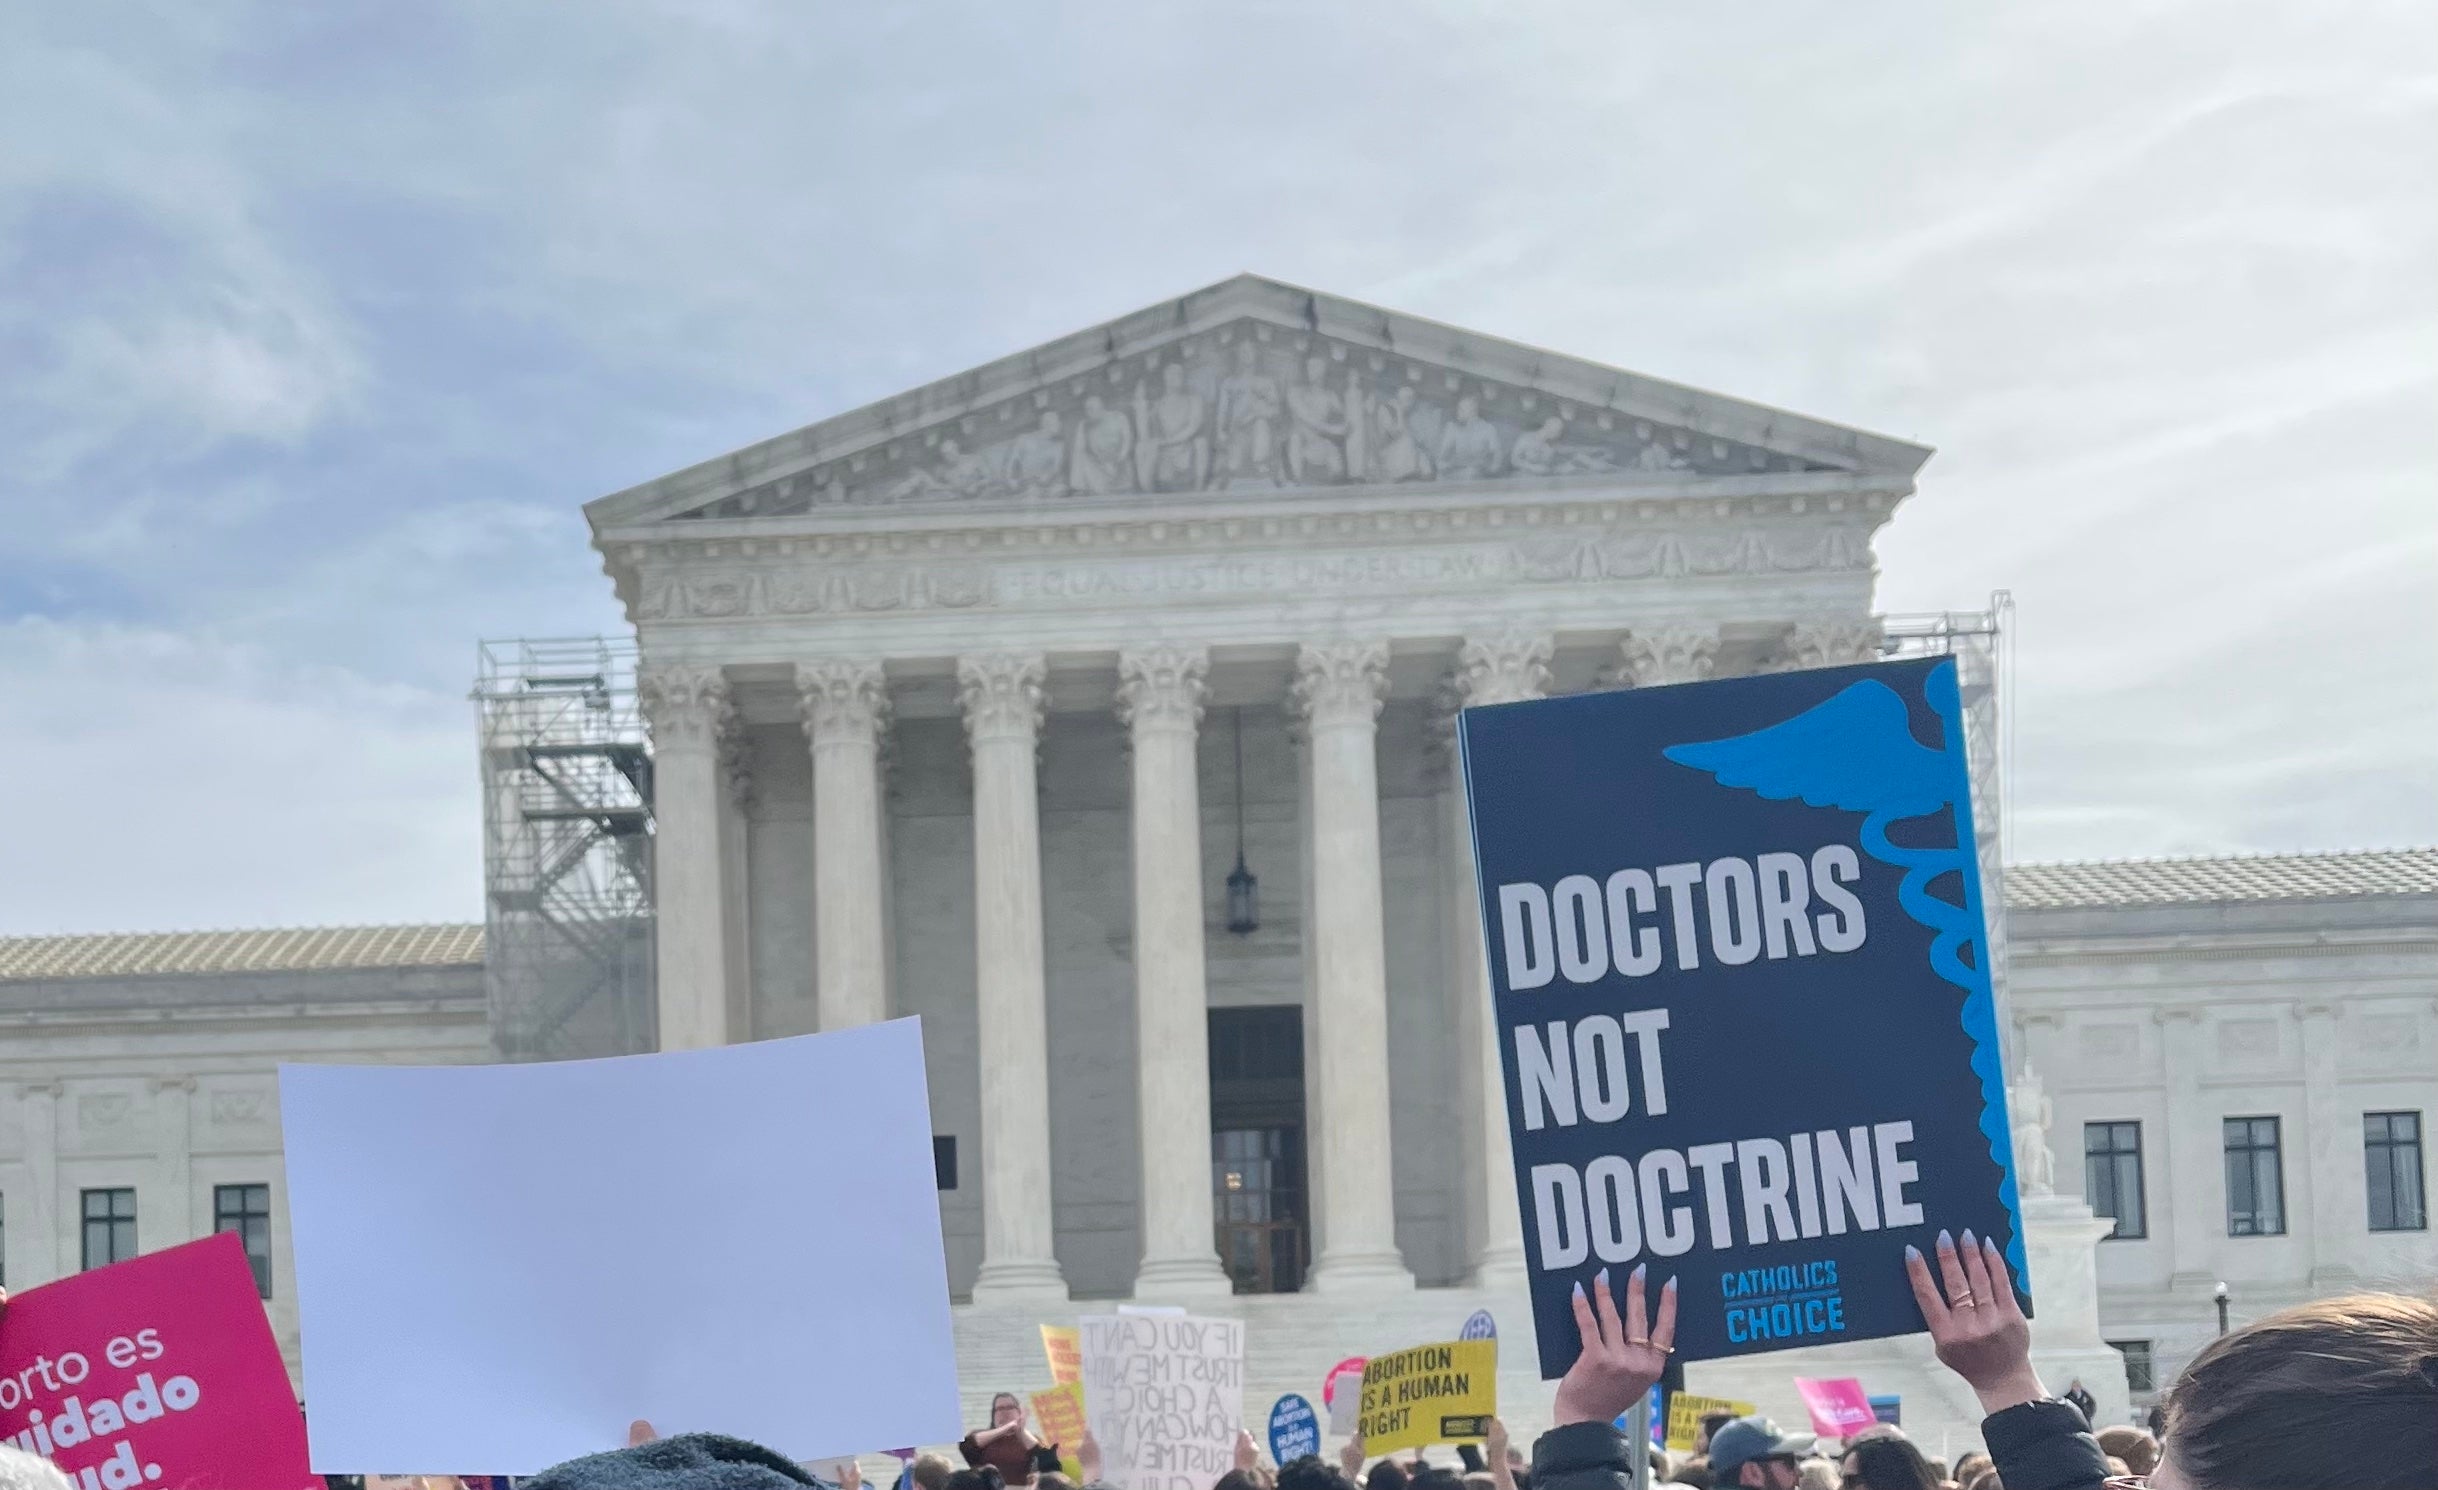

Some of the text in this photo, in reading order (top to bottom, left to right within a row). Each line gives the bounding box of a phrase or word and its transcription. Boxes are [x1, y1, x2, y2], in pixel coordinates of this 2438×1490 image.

[1499, 844, 1866, 990] DOCTORS
[1513, 1007, 1670, 1131] NOT
[1531, 1119, 1925, 1271] DOCTRINE
[1721, 1259, 1838, 1298] CATHOLICS
[1727, 1297, 1846, 1343] CHOICE
[0, 1327, 164, 1410] orto es
[1363, 1347, 1453, 1387] ABORTION
[1361, 1389, 1377, 1413] IS
[1381, 1385, 1392, 1407] A
[1398, 1373, 1470, 1403] HUMAN
[1358, 1407, 1411, 1438] RIGHT
[1669, 1426, 1696, 1441] RIGH
